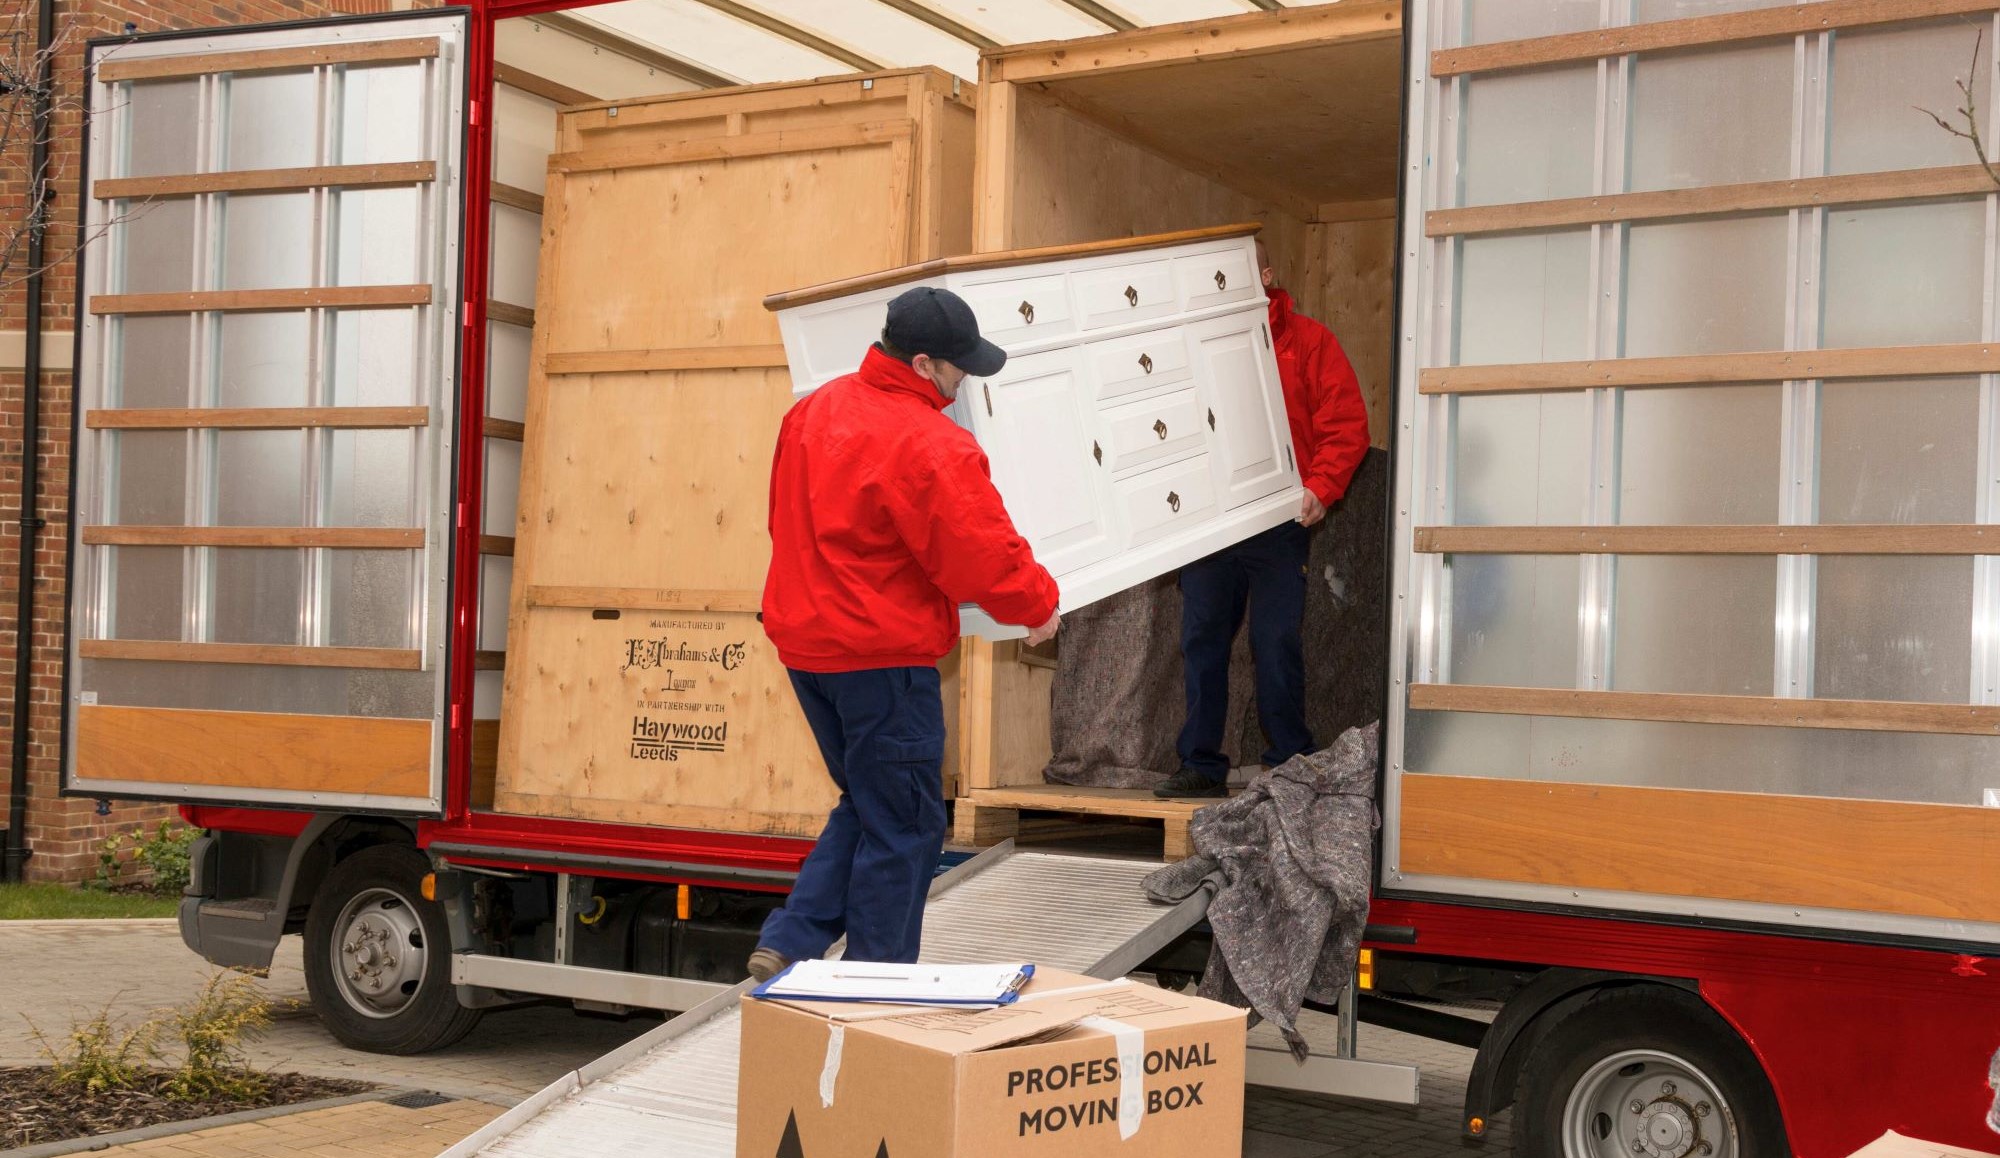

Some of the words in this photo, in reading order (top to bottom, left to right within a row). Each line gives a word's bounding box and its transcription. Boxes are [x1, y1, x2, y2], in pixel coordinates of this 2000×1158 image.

[649, 620, 713, 630] MANUFACTURED
[715, 621, 726, 631] BY
[637, 700, 645, 709] IN
[647, 700, 701, 712] PARTNERSHIP
[705, 703, 725, 713] WITH
[632, 716, 728, 742] Haywood
[630, 743, 678, 762] Leeds
[1147, 1081, 1204, 1115] BOX
